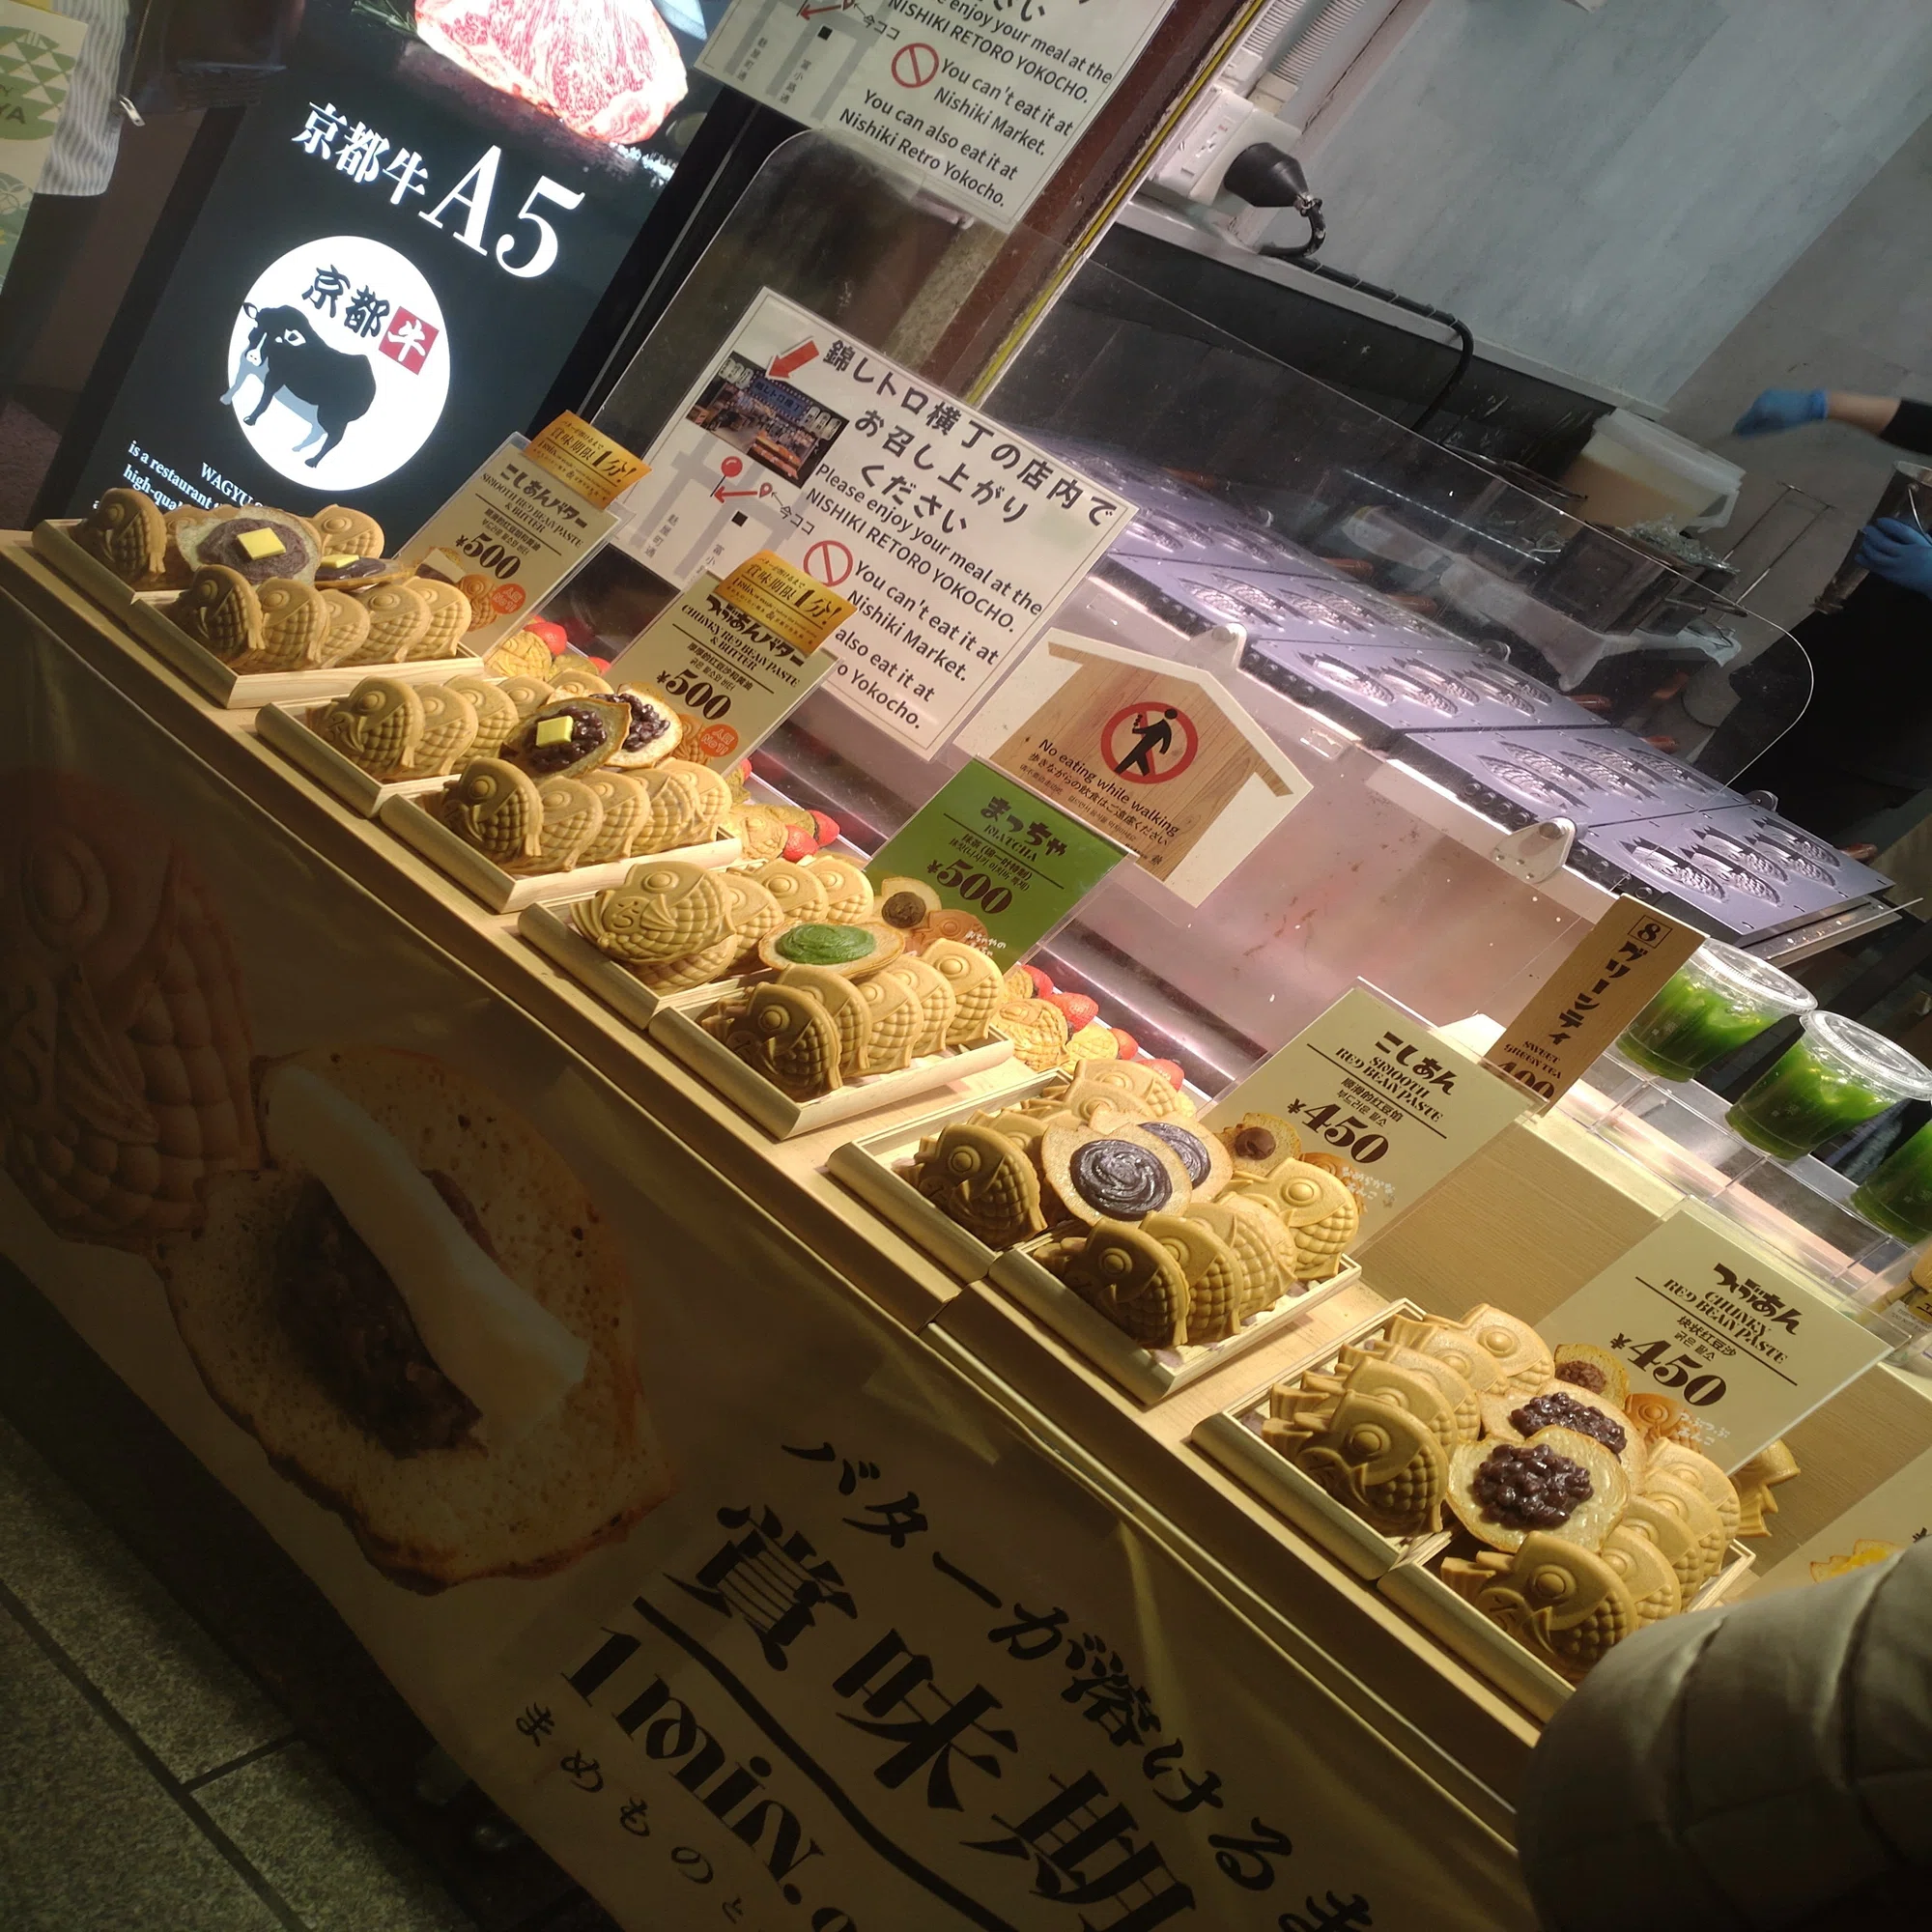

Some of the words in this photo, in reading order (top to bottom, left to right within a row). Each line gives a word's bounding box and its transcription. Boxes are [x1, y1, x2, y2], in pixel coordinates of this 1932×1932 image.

[888, 0, 949, 33] NISHIKI
[950, 24, 1014, 64] RETORO
[1015, 56, 1088, 103] YOKOCHO.
[949, 0, 993, 28] enjoy
[991, 18, 1031, 43] your
[1033, 37, 1070, 63] meal
[1068, 55, 1087, 71] at
[1087, 62, 1113, 84] the
[934, 87, 993, 126] Nishiki
[991, 116, 1045, 156] Market.
[941, 58, 971, 84] You
[972, 77, 1014, 106] can't
[1014, 99, 1041, 121] eat
[1041, 109, 1054, 128] it
[1054, 120, 1074, 136] at
[838, 108, 899, 147] Nishiki
[897, 138, 941, 170] Retro
[945, 160, 1005, 208] Yokocho.
[864, 89, 895, 116] You
[895, 108, 924, 131] can
[924, 123, 959, 149] also
[960, 144, 987, 165] eat
[986, 153, 1001, 171] it
[1000, 164, 1018, 181] at
[291, 101, 429, 205] 京都牛
[418, 145, 585, 277] A5
[301, 264, 426, 363] 京都牛
[123, 464, 184, 510] high-qua
[128, 440, 140, 457] is
[140, 452, 150, 464] a
[150, 458, 213, 511] restaurant
[201, 462, 253, 507] WAGYU
[500, 463, 588, 528] こしあんバター
[854, 410, 1030, 524] お召し上がり
[861, 464, 967, 533] ください
[482, 472, 516, 502] SMOOTH
[515, 494, 532, 514] RED
[532, 505, 556, 529] BEAN
[554, 520, 583, 548] PASTE
[512, 507, 546, 533] BUTTER
[781, 505, 815, 536] 今ココ
[815, 464, 866, 503] Please
[867, 498, 914, 533] enjoy
[910, 526, 951, 555] your
[949, 551, 993, 583] meal
[991, 578, 1012, 597] at
[1011, 587, 1044, 615] the
[456, 533, 521, 580] ¥500
[806, 488, 867, 533] NISHIKI
[866, 526, 931, 575] RETORO
[930, 568, 1014, 633] YOKOCHO.
[682, 604, 723, 637] CHUNKY
[723, 629, 742, 649] RED
[741, 640, 769, 667] BEAN
[766, 659, 800, 688] PASTE
[706, 594, 804, 668] つぶあんバター
[847, 589, 906, 637] Nishiki
[902, 629, 966, 681] Market.
[854, 560, 886, 591] You
[886, 582, 930, 621] can't
[928, 615, 960, 641] eat
[958, 630, 978, 652] it
[976, 644, 1000, 666] at
[710, 637, 719, 646] &
[718, 640, 757, 671] BUTTER
[835, 628, 868, 657] also
[869, 655, 897, 678] eat
[897, 668, 914, 689] it
[913, 683, 936, 702] at
[657, 668, 731, 720] ¥500
[850, 668, 921, 729] Yokocho.
[1027, 753, 1168, 846] 歩きながらの飲食はご遠慮ください
[1038, 738, 1058, 756] No
[1060, 754, 1096, 783] eating
[1097, 780, 1130, 805] while
[1130, 803, 1180, 838] walking
[980, 796, 1067, 857] まっちゃ
[983, 824, 1038, 862] MATCHA
[927, 859, 1012, 914] ¥500
[1637, 923, 1661, 942] 8
[1548, 941, 1648, 1045] グリーンティ
[1336, 1047, 1364, 1068] RED
[1363, 1066, 1401, 1094] BEAN
[1400, 1091, 1444, 1122] PASTE
[1370, 1056, 1430, 1098] SMOOTH
[1375, 1031, 1457, 1095] こしあん
[1504, 1043, 1543, 1068] GREEN
[1542, 1061, 1561, 1079] TEA
[1522, 1040, 1560, 1064] SWEET
[1287, 1098, 1389, 1163] ¥450
[1663, 1279, 1697, 1303] RED
[1695, 1299, 1740, 1333] BEAN
[1735, 1327, 1788, 1364] PASTE
[1705, 1292, 1767, 1337] CHUNKY
[1713, 1263, 1802, 1335] つぶあん
[1610, 1333, 1726, 1406] ¥450
[663, 1504, 1196, 1932] 賞味期
[561, 1627, 824, 1905] 1min.
